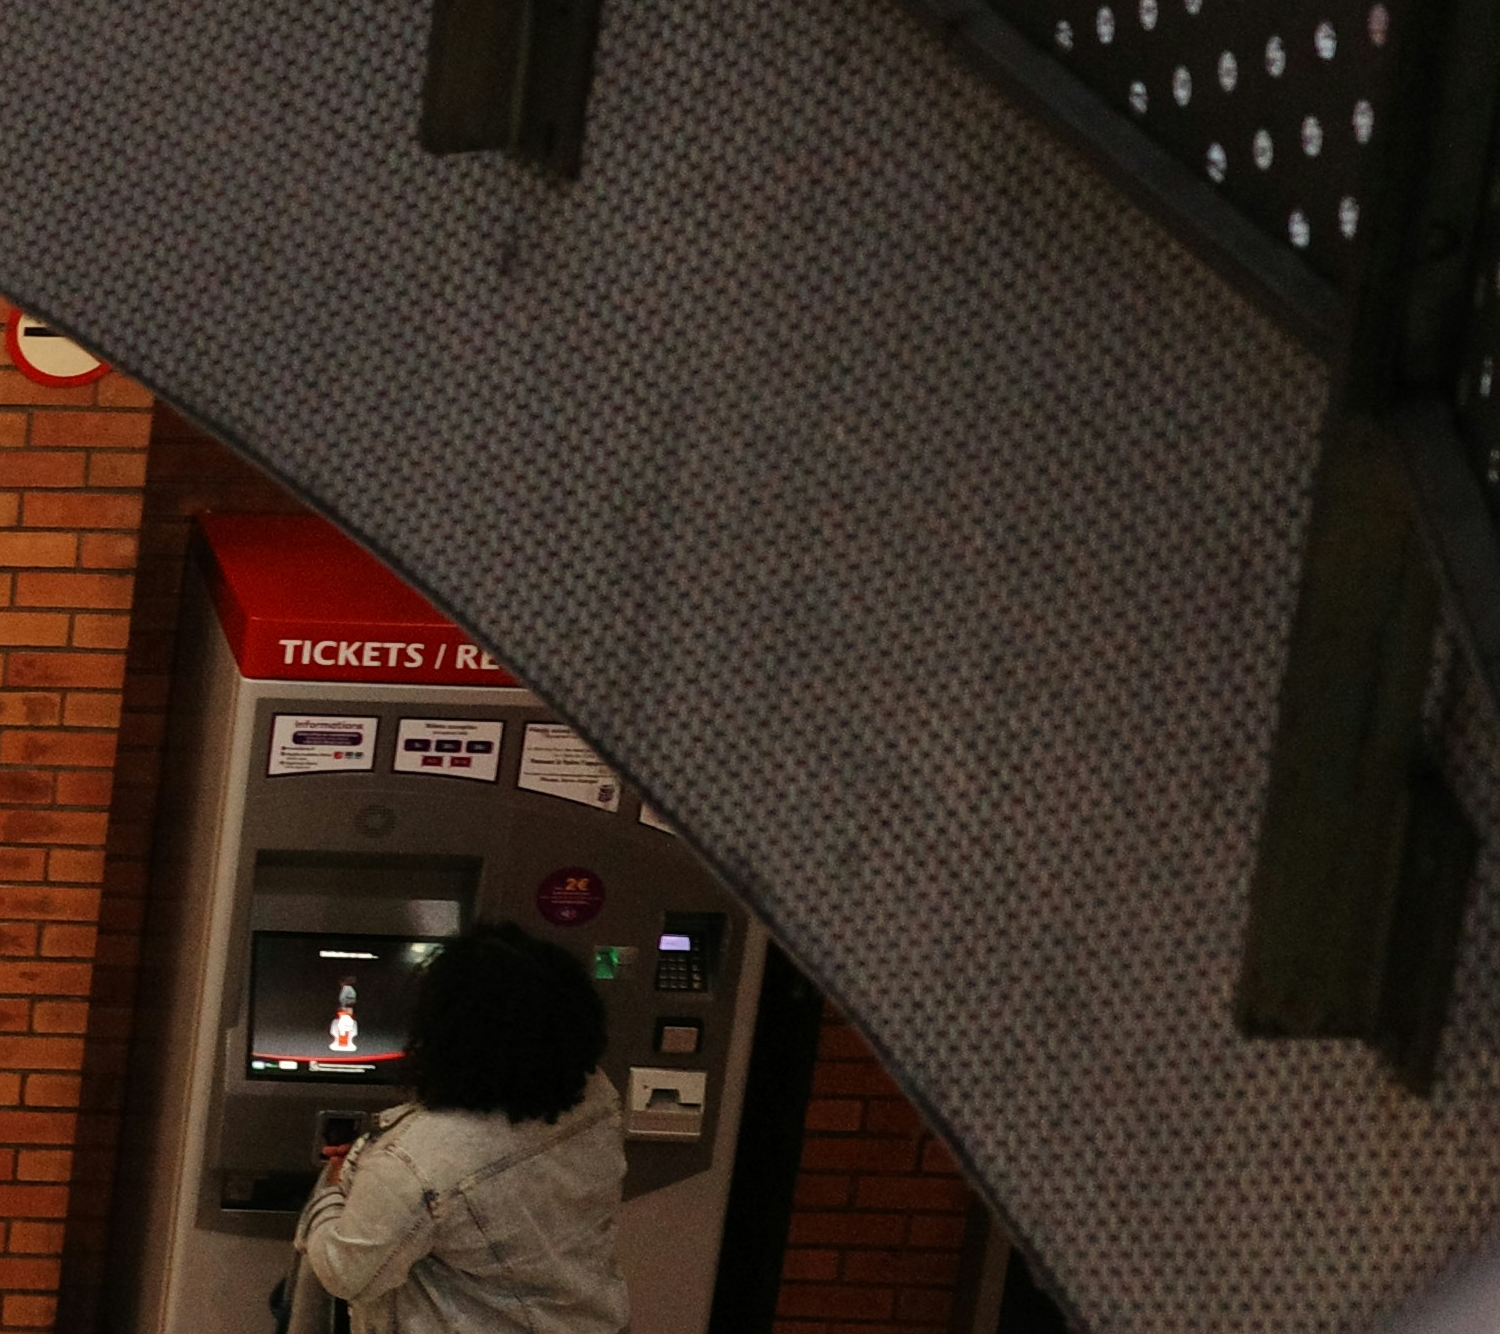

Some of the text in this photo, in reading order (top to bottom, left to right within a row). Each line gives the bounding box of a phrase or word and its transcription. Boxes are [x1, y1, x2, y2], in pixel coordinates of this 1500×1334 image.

[278, 638, 501, 671] TICKETS / RE
